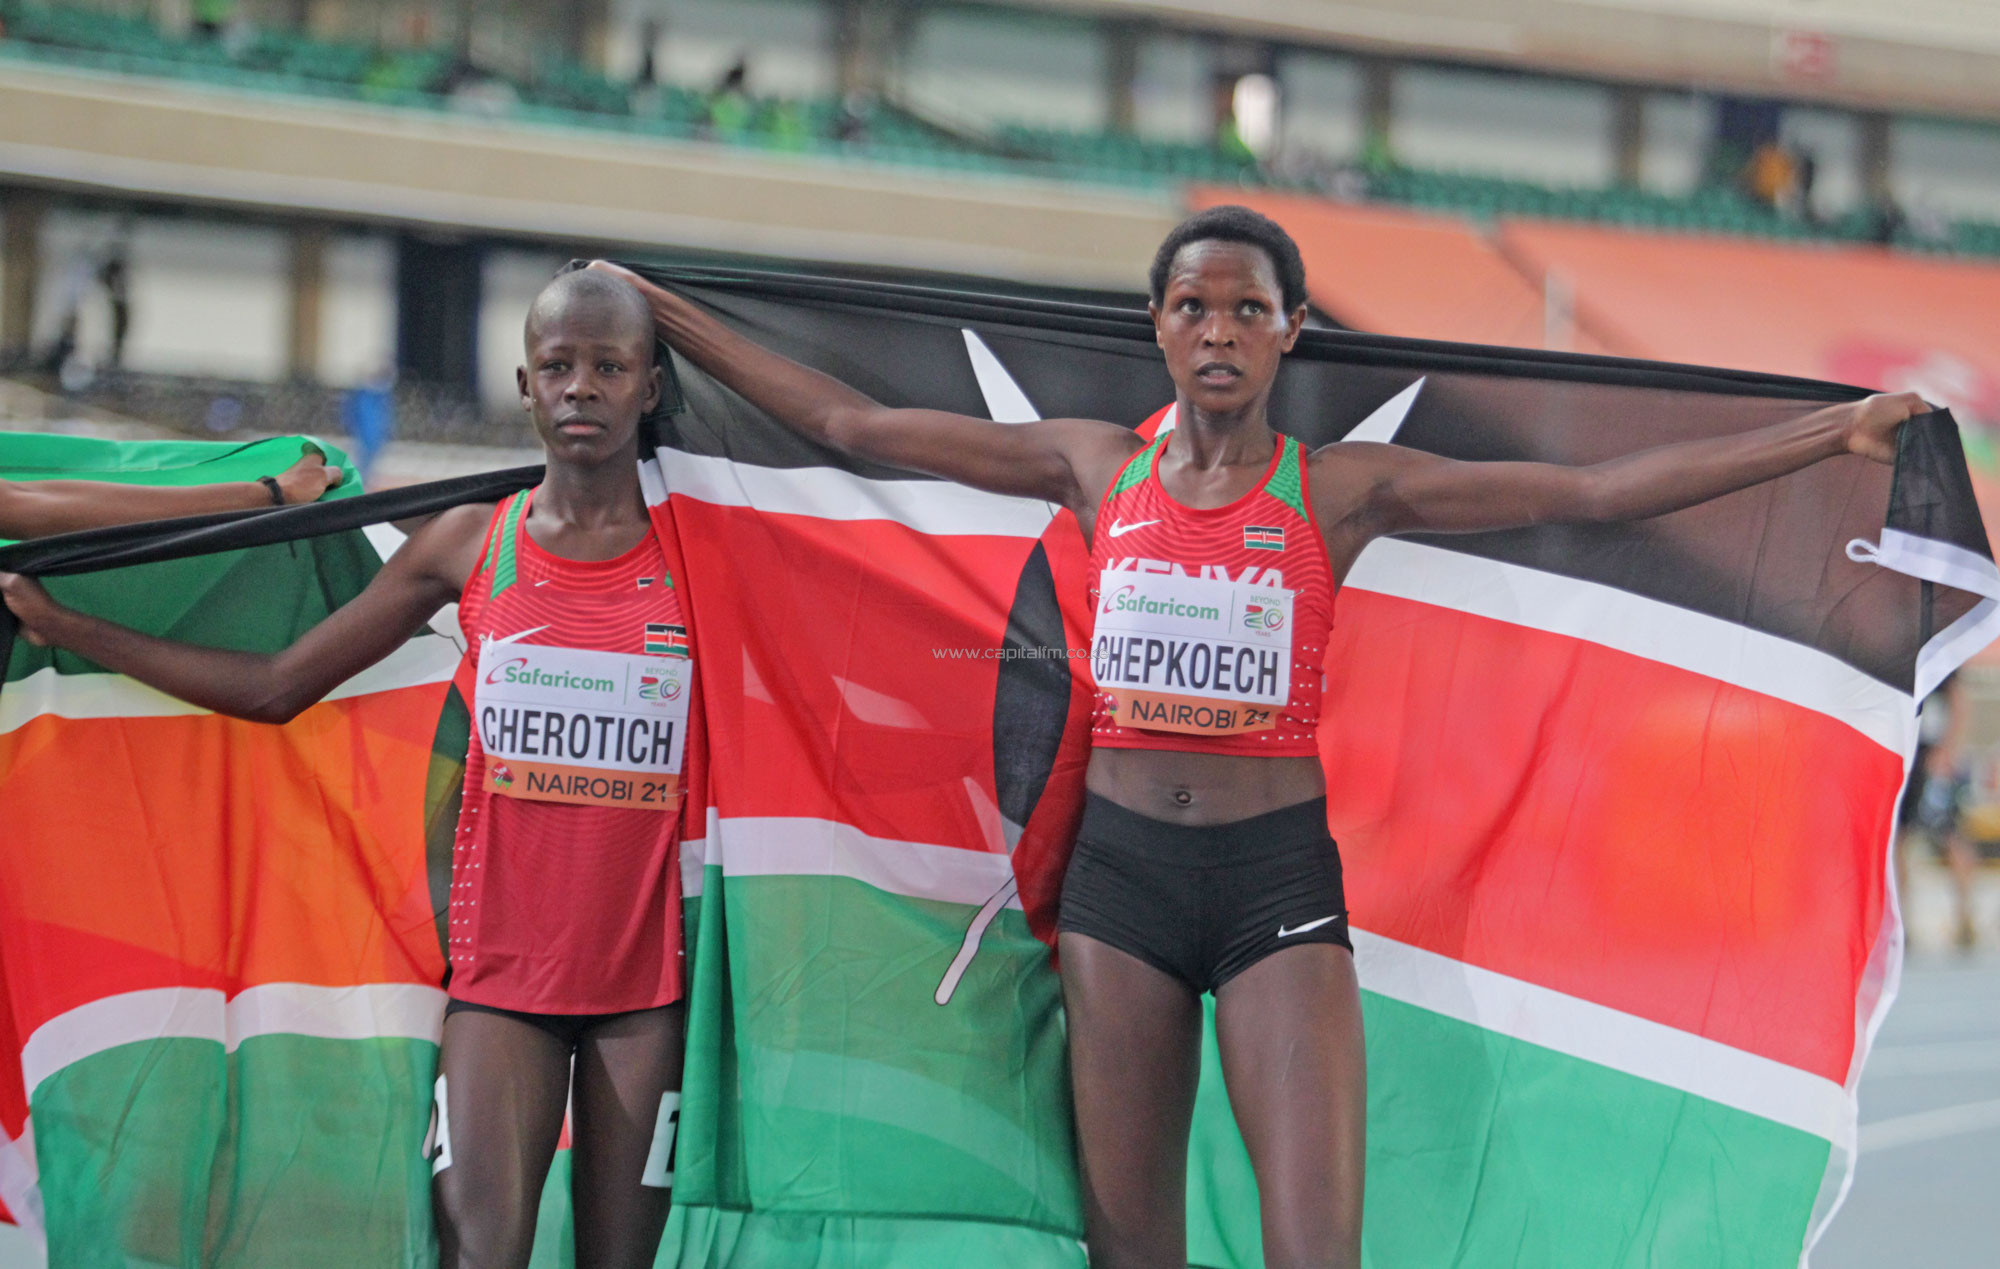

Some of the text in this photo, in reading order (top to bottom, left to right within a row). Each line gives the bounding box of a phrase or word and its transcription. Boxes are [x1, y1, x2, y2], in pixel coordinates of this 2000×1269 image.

[1116, 594, 1219, 620] Safaricom
[1250, 594, 1281, 606] BEYOND
[504, 666, 614, 692] Safaricom
[1095, 635, 1278, 697] CHEPKOECH
[1131, 700, 1237, 729] NAIROBI
[482, 706, 674, 765] CHEROTICH
[527, 772, 667, 802] NAIROBI 21
